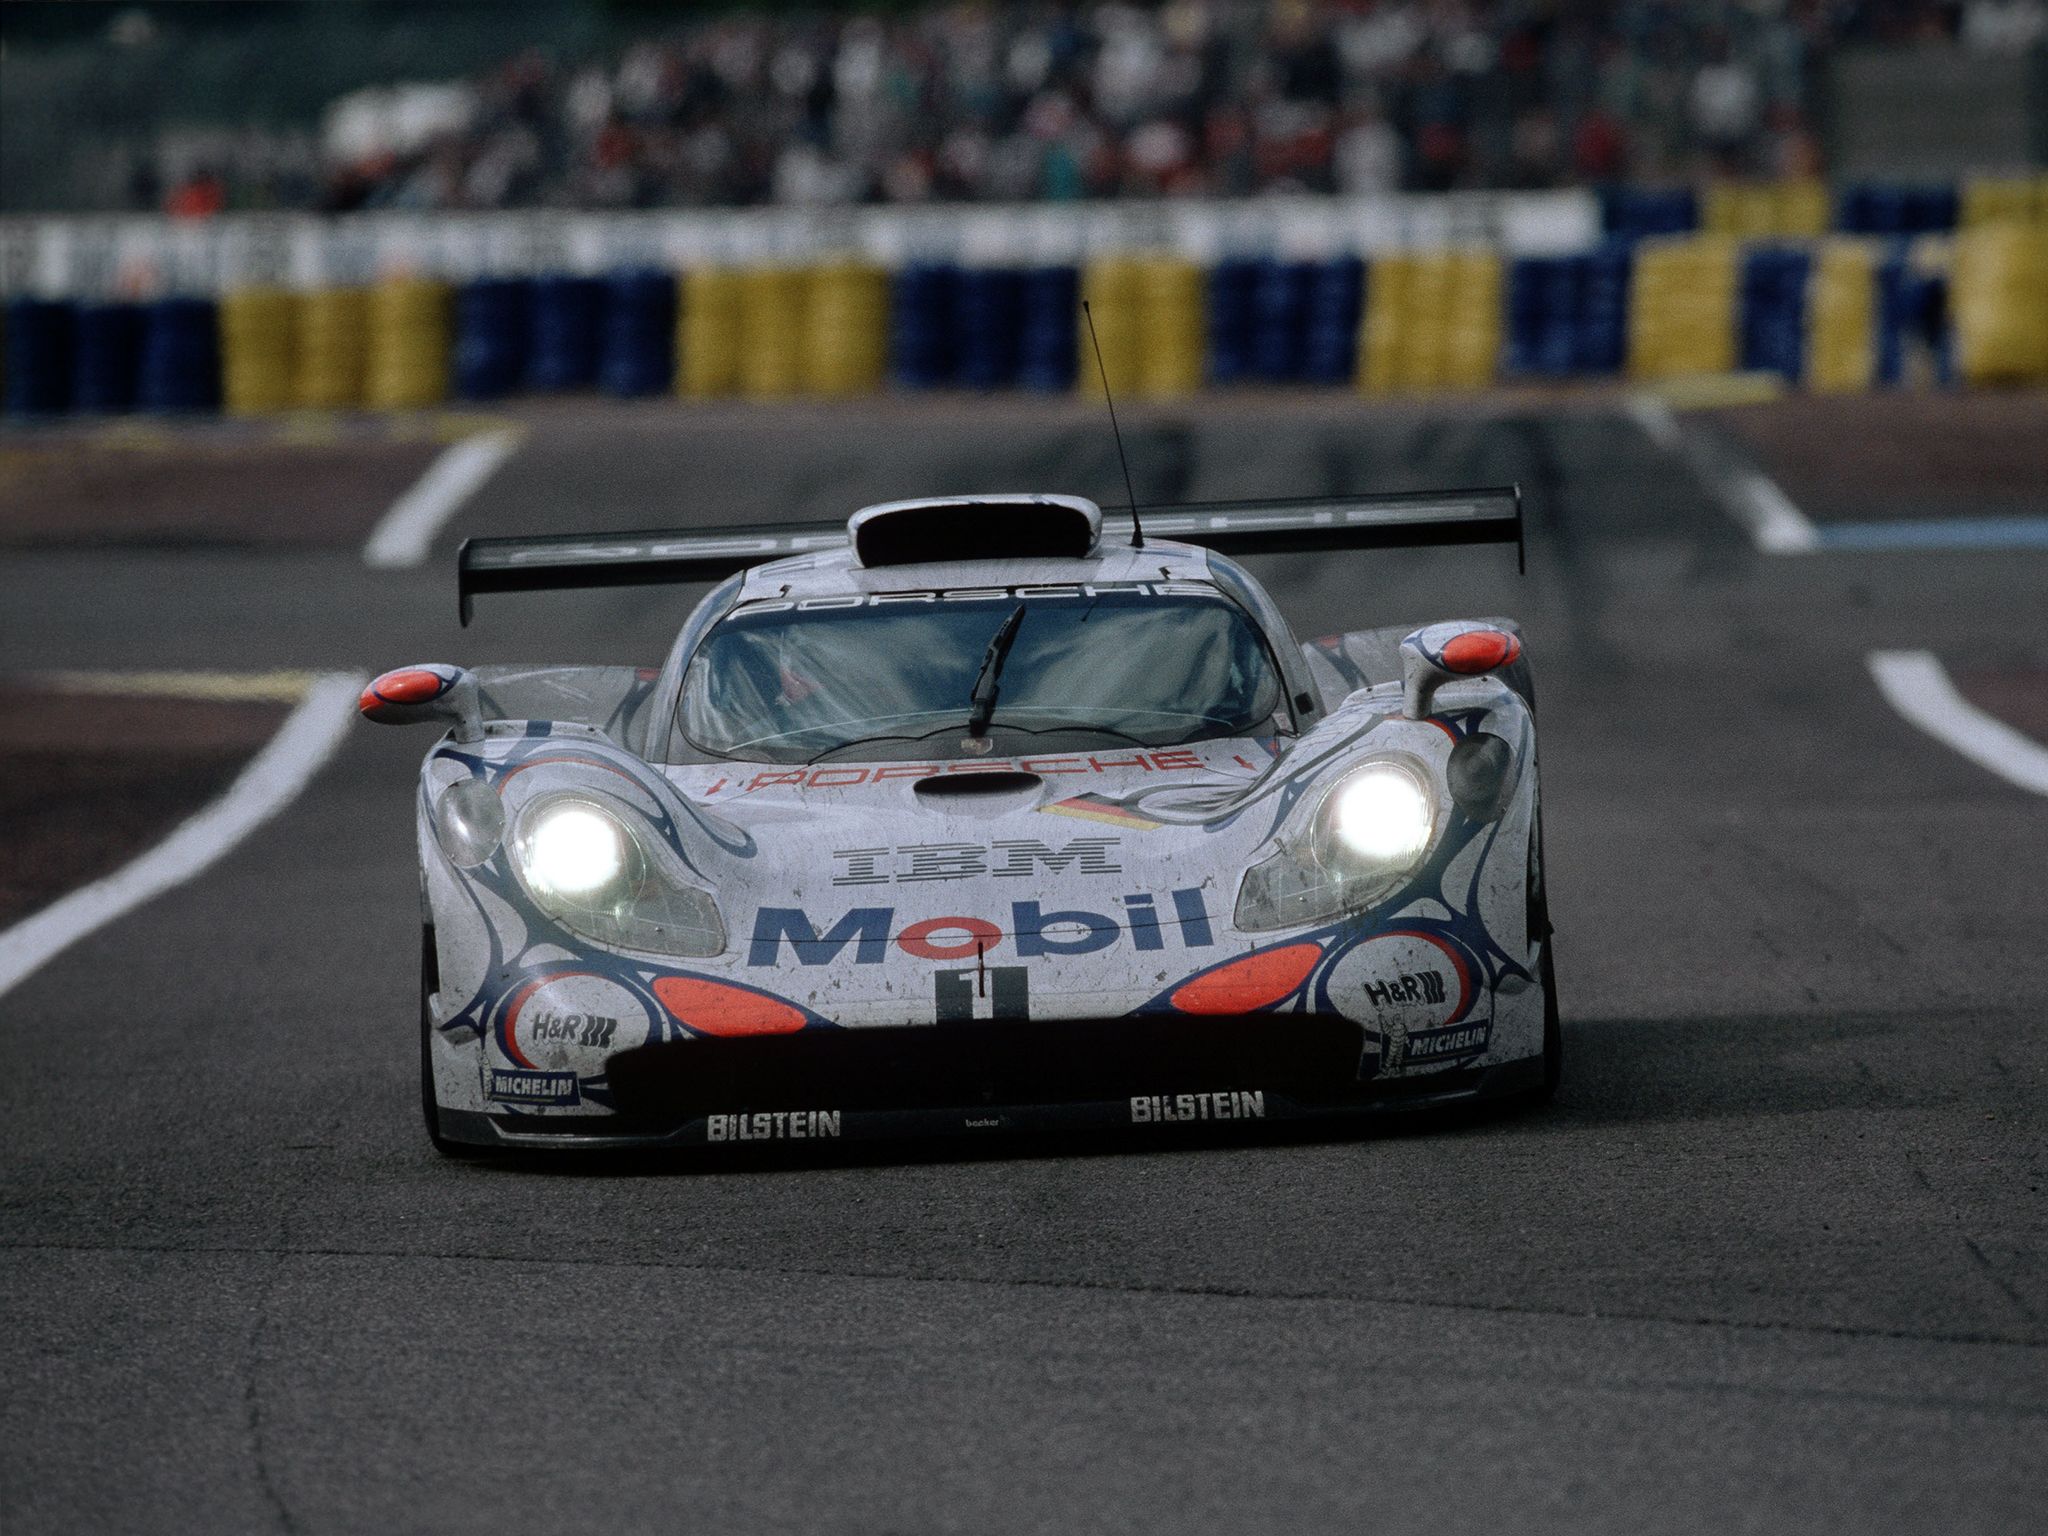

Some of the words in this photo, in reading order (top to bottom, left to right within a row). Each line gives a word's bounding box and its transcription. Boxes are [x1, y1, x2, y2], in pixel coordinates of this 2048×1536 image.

[727, 584, 1222, 621] PORSCHE
[833, 837, 1122, 886] IBM
[747, 888, 1215, 966] Mobil
[959, 969, 994, 1019] 1
[1364, 974, 1422, 1007] H&R
[532, 1012, 582, 1041] H&R
[1411, 1026, 1487, 1055] MICHELIN
[495, 1076, 573, 1096] MICHELIN
[1131, 1090, 1265, 1123] BILSTEIN
[707, 1110, 841, 1142] BILSTEIN
